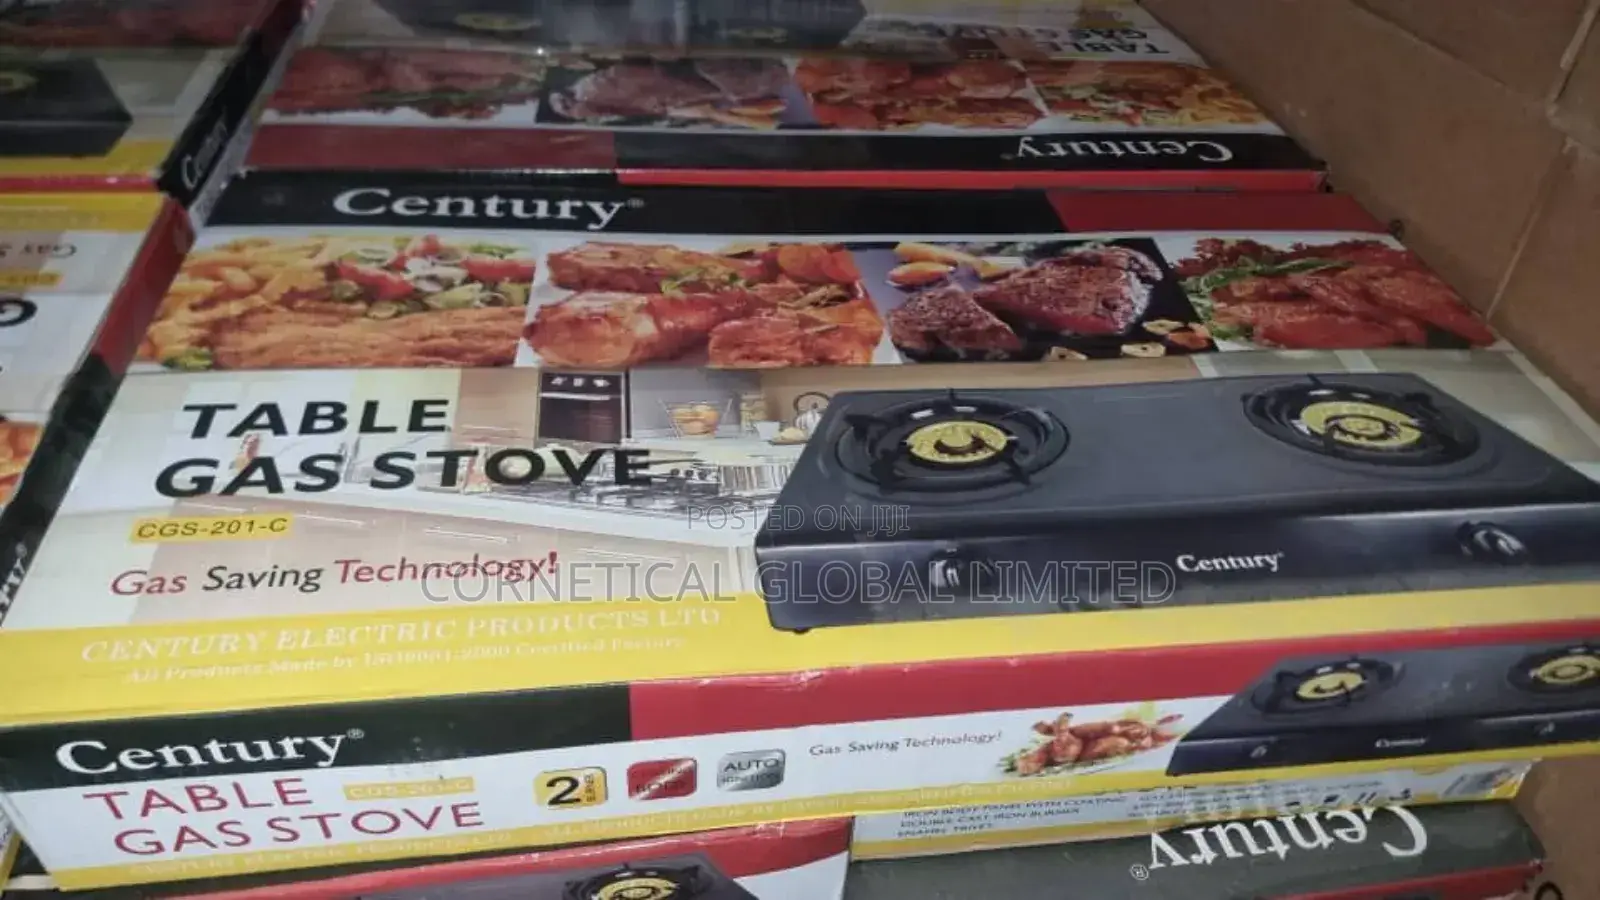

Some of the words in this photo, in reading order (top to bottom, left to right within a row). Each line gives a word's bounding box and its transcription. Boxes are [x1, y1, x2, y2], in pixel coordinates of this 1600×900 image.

[183, 399, 451, 439] TABLE
[155, 452, 345, 498] GAS
[370, 448, 653, 490] STOVE
[136, 517, 288, 540] CGS-201-C
[111, 569, 188, 596] Gas
[202, 563, 323, 593] Saving
[334, 551, 557, 587] Technology!
[82, 629, 267, 662] CENTURY
[277, 618, 457, 651] ELECTRIC
[468, 609, 649, 638] PRODUCTS
[809, 743, 842, 756] Gas
[848, 738, 900, 755] Saving
[905, 730, 1003, 749] Technology!
[723, 756, 782, 773] AUTO
[83, 777, 314, 820] TABLE
[546, 775, 582, 806] 2
[113, 820, 252, 856] GAS
[272, 801, 486, 844] STOVE
